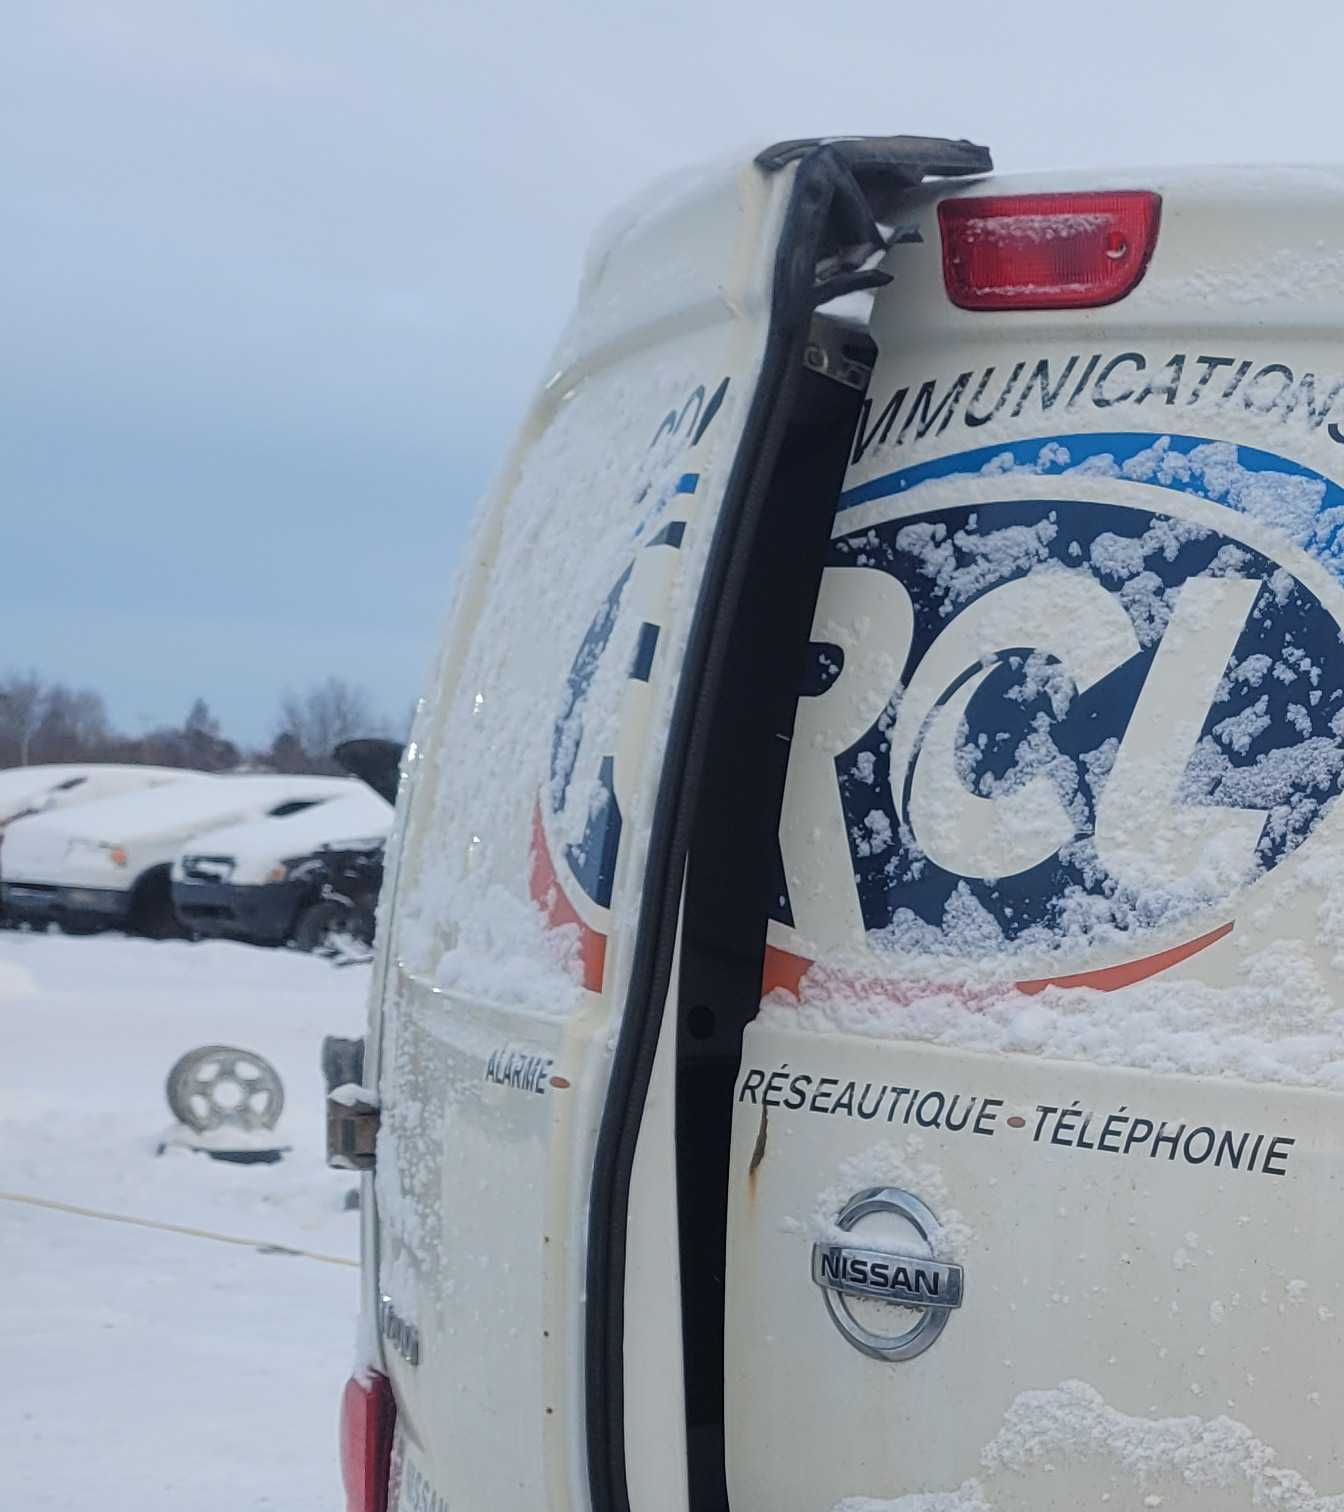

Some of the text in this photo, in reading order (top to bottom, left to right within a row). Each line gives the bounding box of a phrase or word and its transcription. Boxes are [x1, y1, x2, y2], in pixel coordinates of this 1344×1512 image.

[738, 1065, 1297, 1178] RÉSEAUTIQUE TÉLÉPHONIE
[820, 1252, 941, 1297] NISSAN
